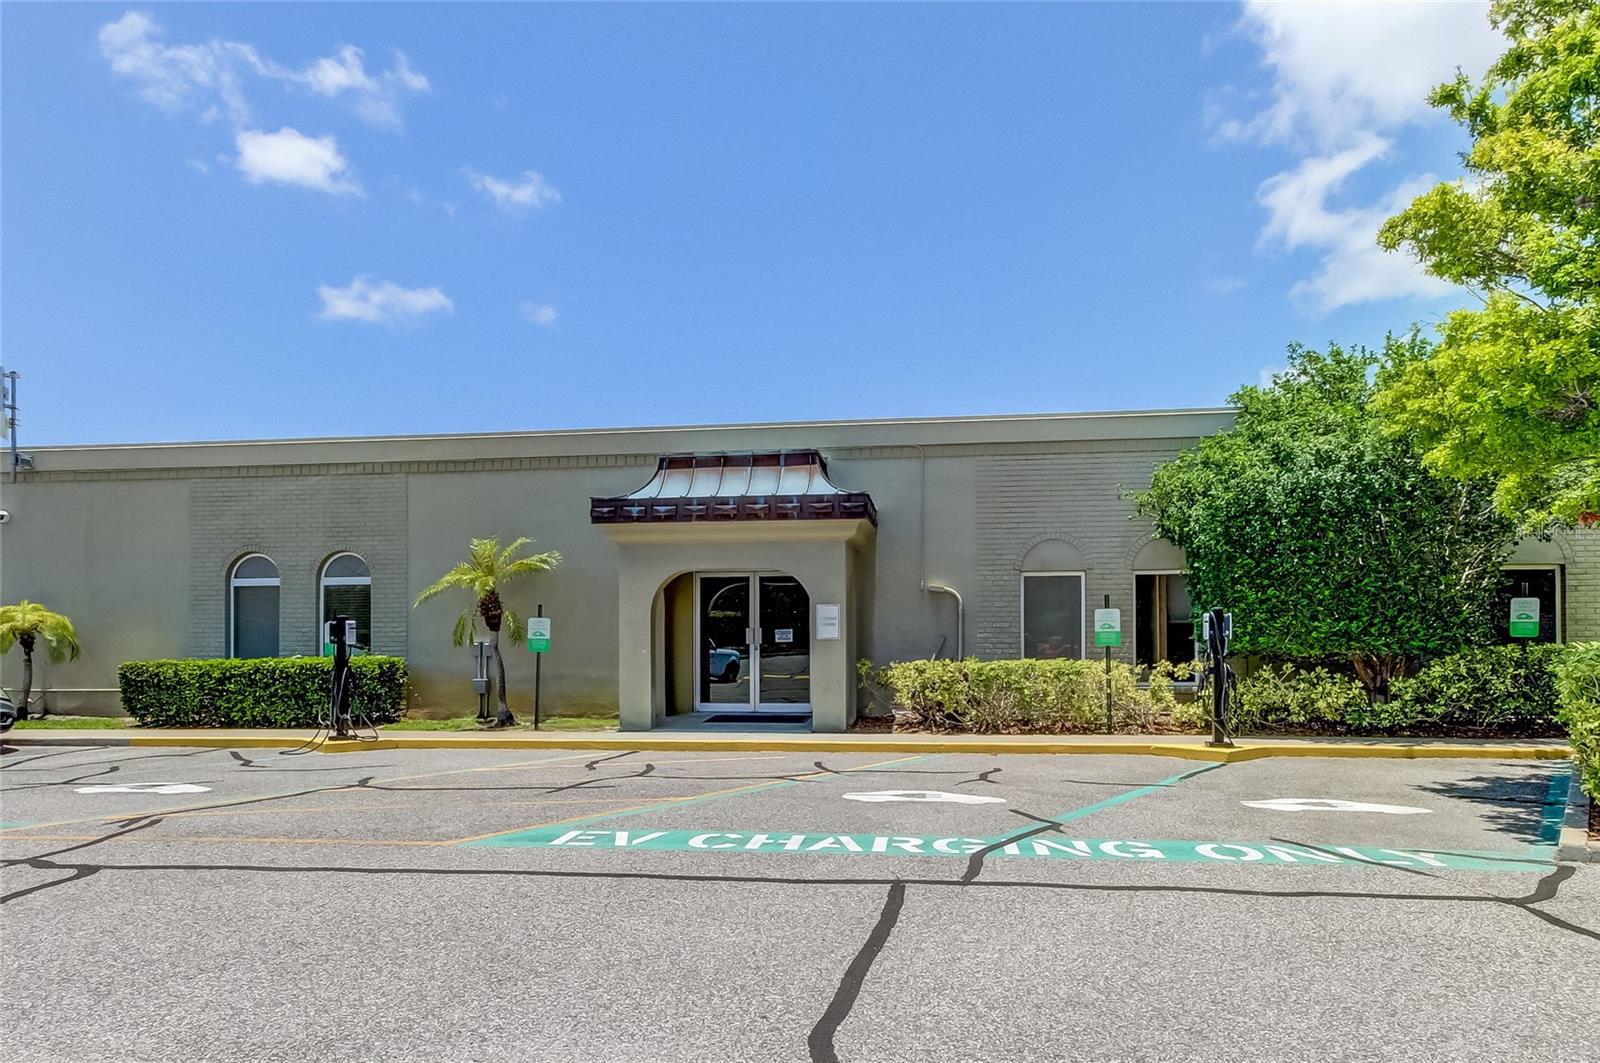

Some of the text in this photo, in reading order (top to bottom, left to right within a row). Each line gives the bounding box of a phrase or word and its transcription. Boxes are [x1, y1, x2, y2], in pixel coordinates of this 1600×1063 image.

[548, 831, 1448, 867] EV CHARGING ONLY
